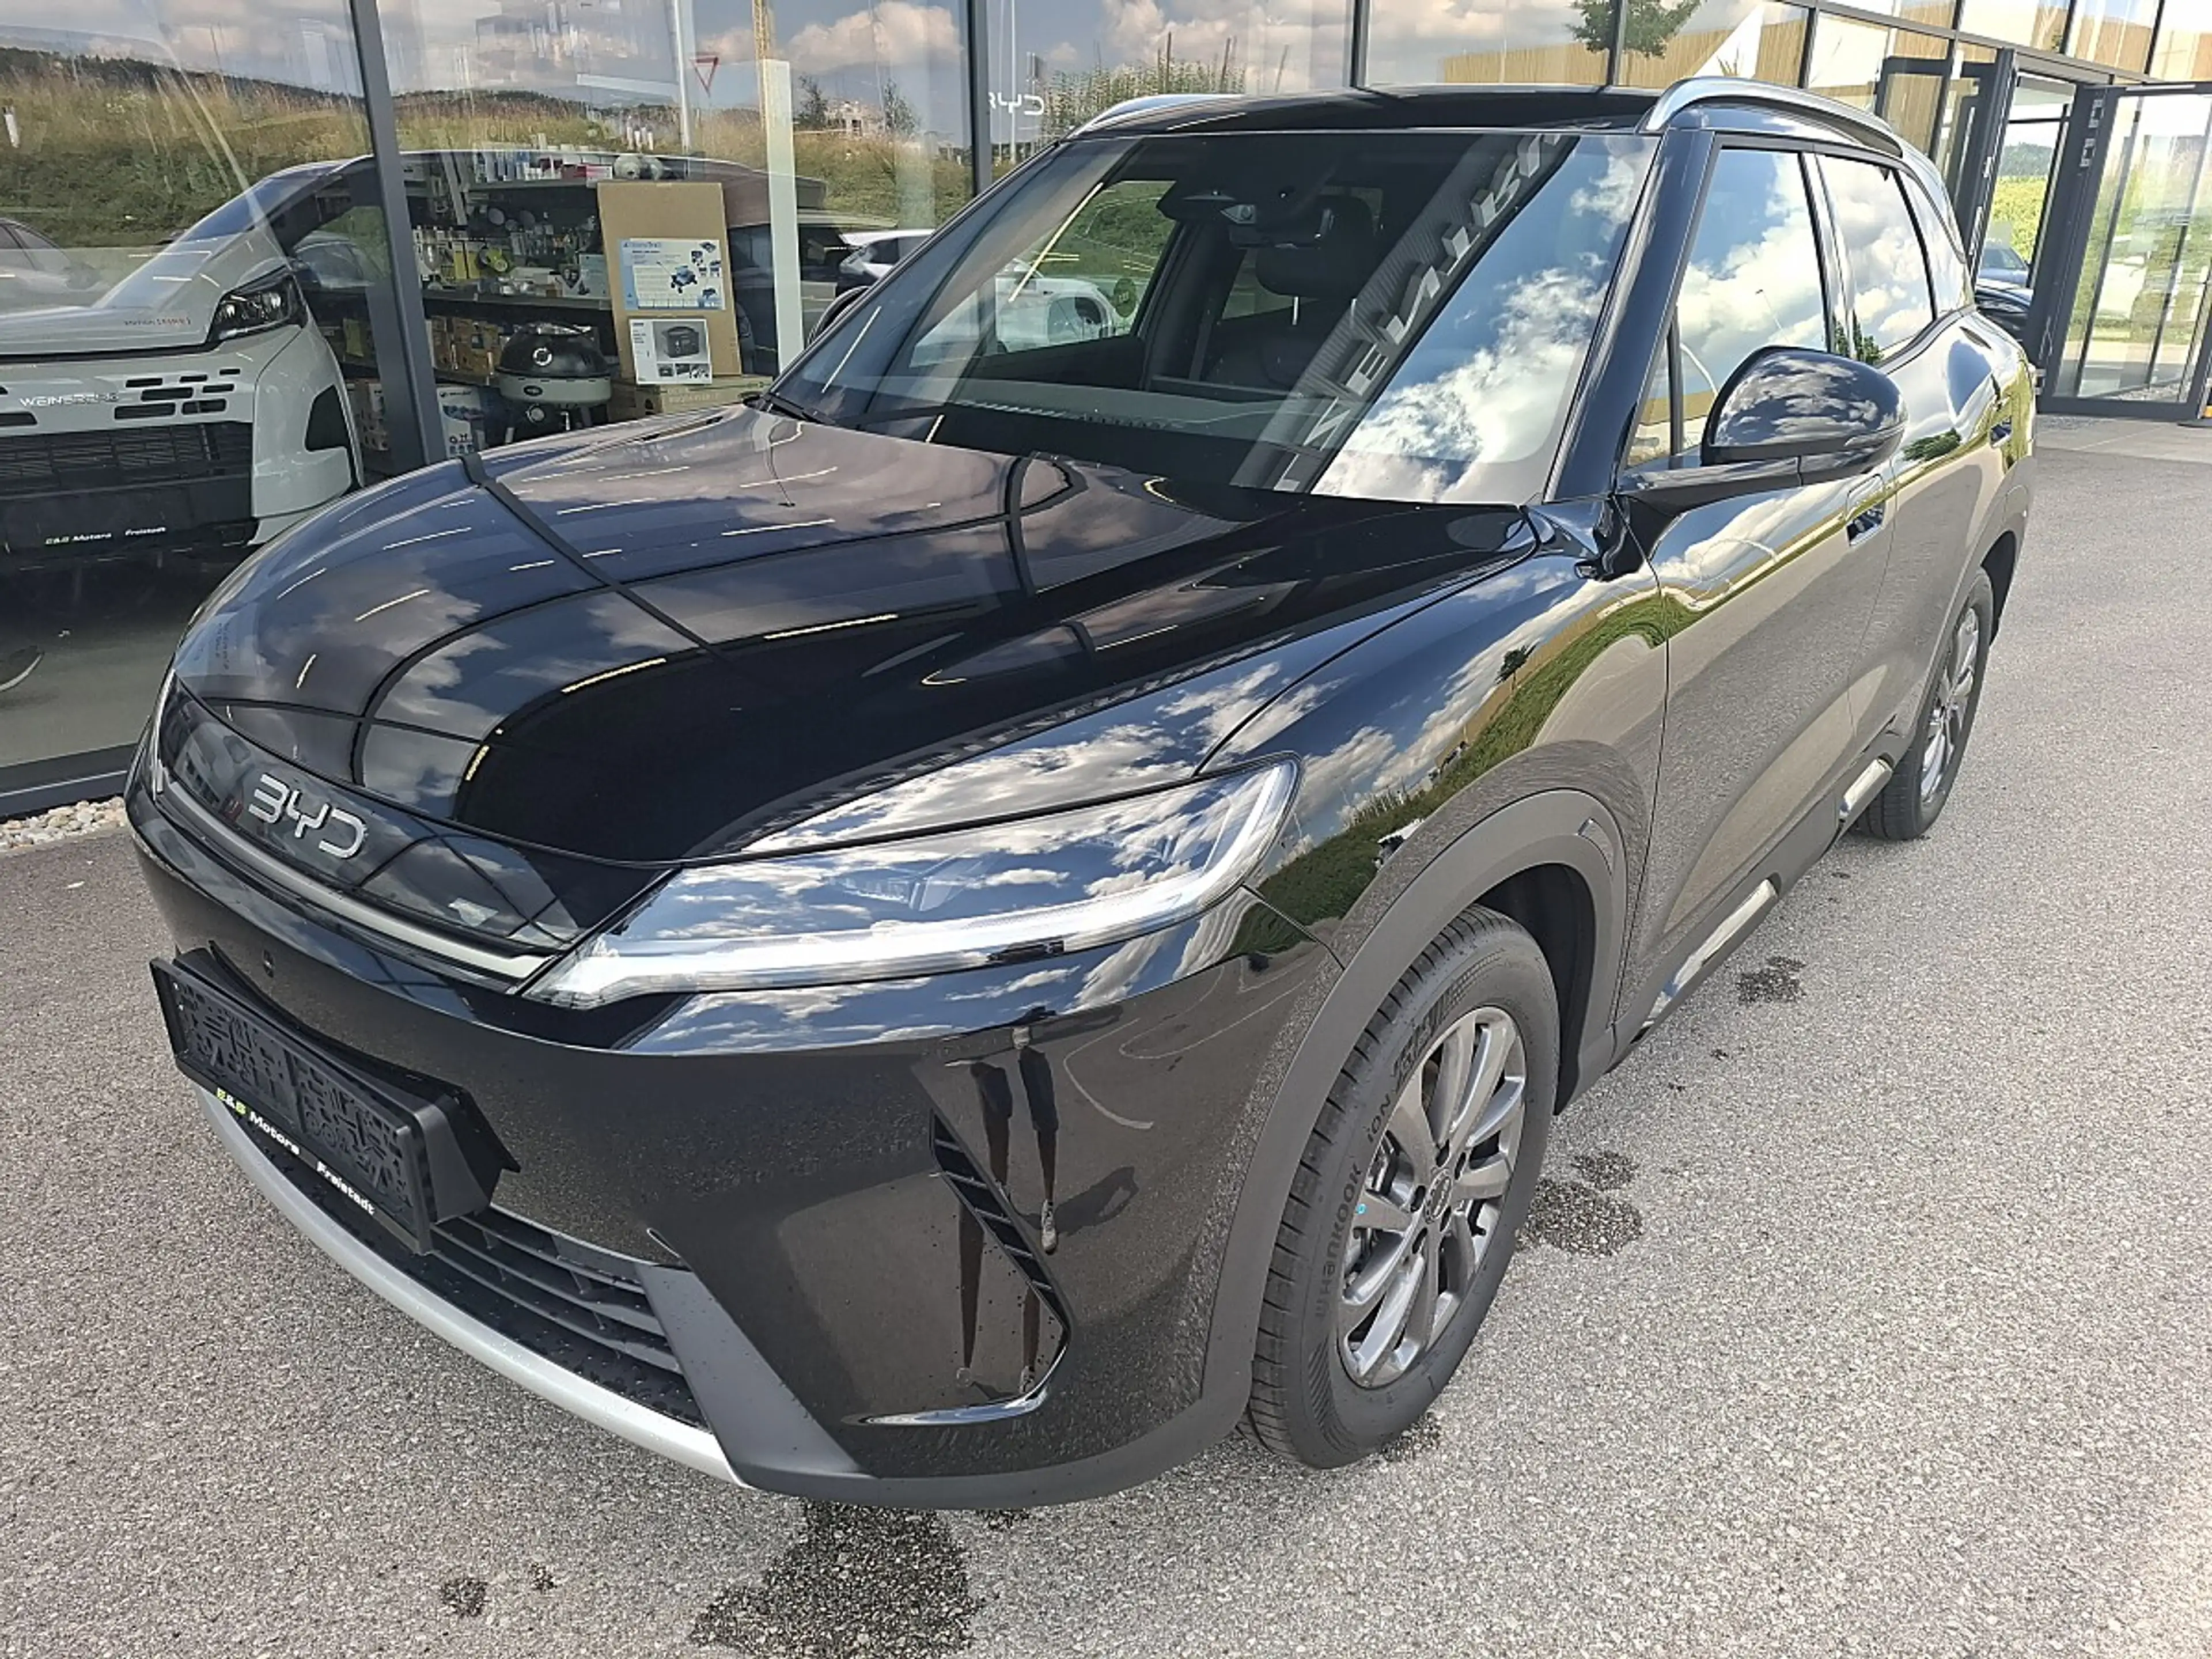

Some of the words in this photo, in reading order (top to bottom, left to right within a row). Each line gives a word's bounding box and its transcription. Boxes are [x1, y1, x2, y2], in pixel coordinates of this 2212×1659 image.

[248, 774, 366, 858] BYD
[249, 1111, 300, 1156] Motors
[317, 1161, 375, 1216] Freistadt
